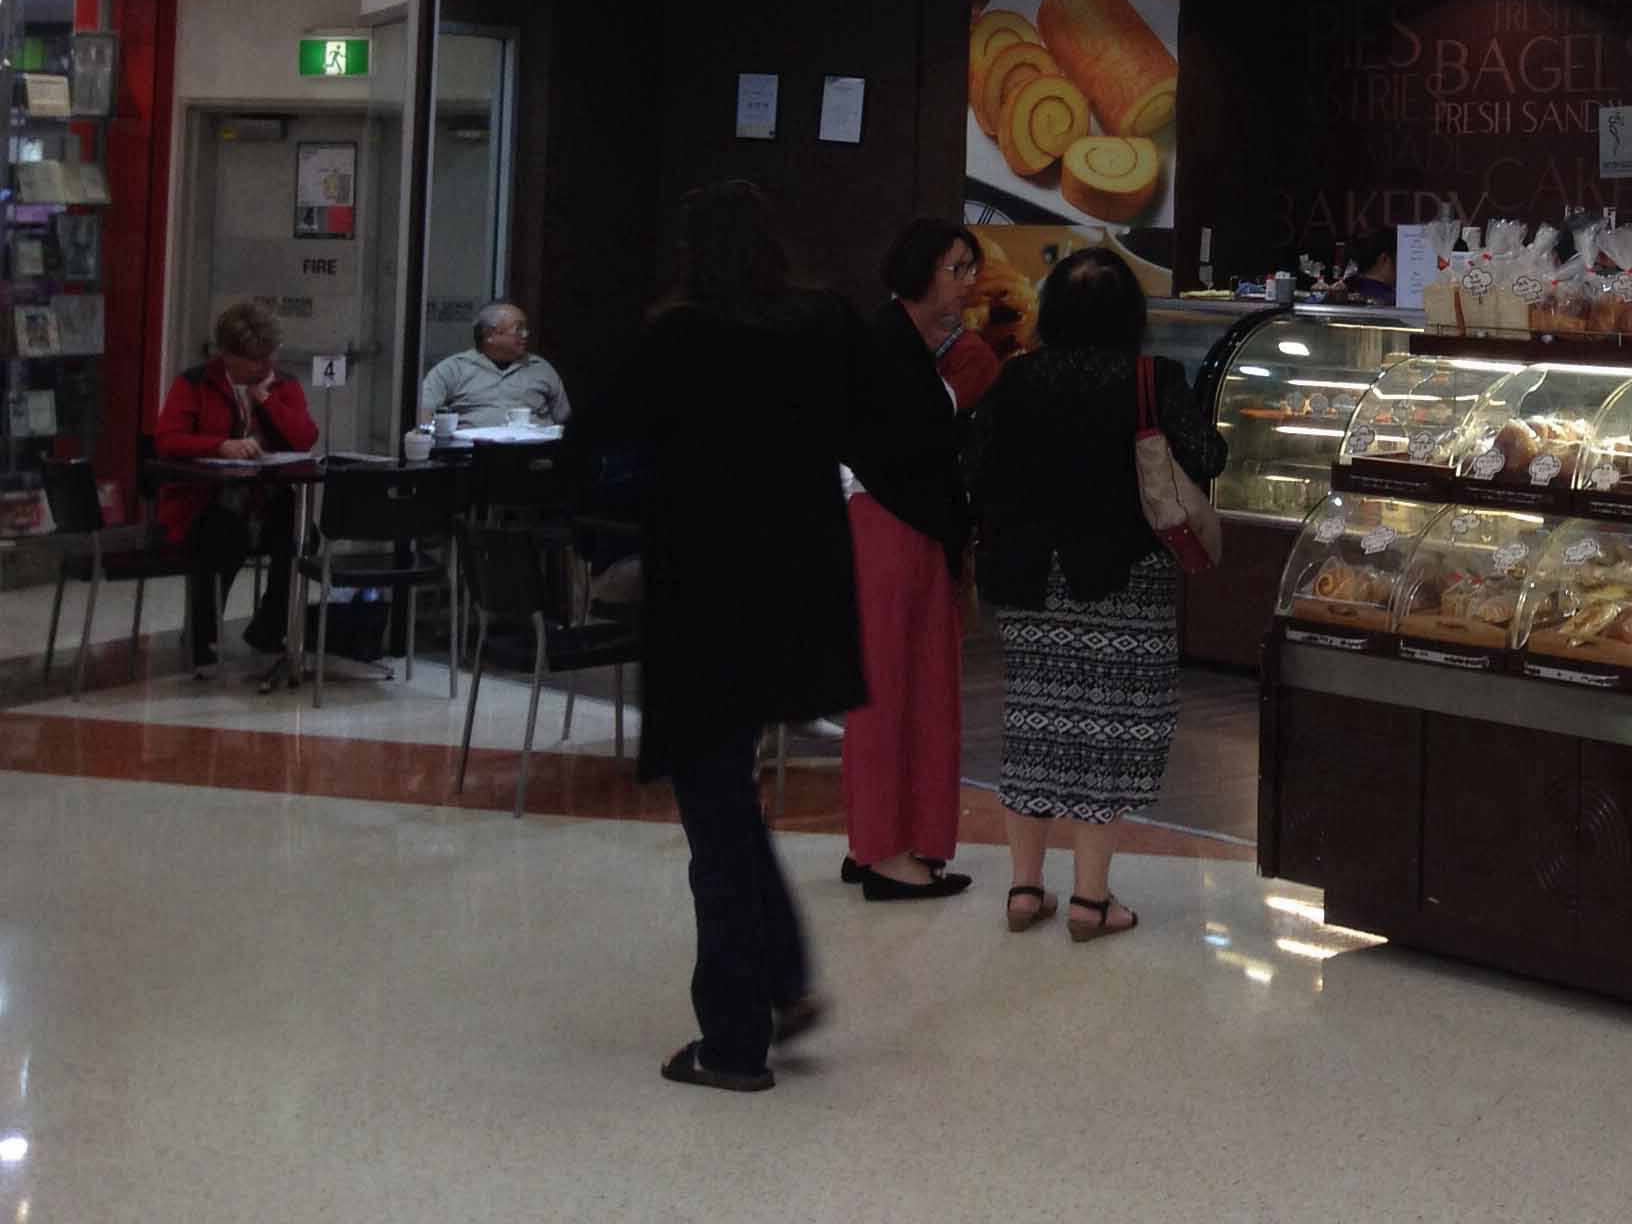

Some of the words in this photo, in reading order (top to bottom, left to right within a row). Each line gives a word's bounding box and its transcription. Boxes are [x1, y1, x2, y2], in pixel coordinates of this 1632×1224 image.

[1432, 98, 1512, 136] FRESH
[1521, 98, 1622, 134] SAND
[303, 258, 337, 276] FIRE
[323, 360, 335, 378] 4
